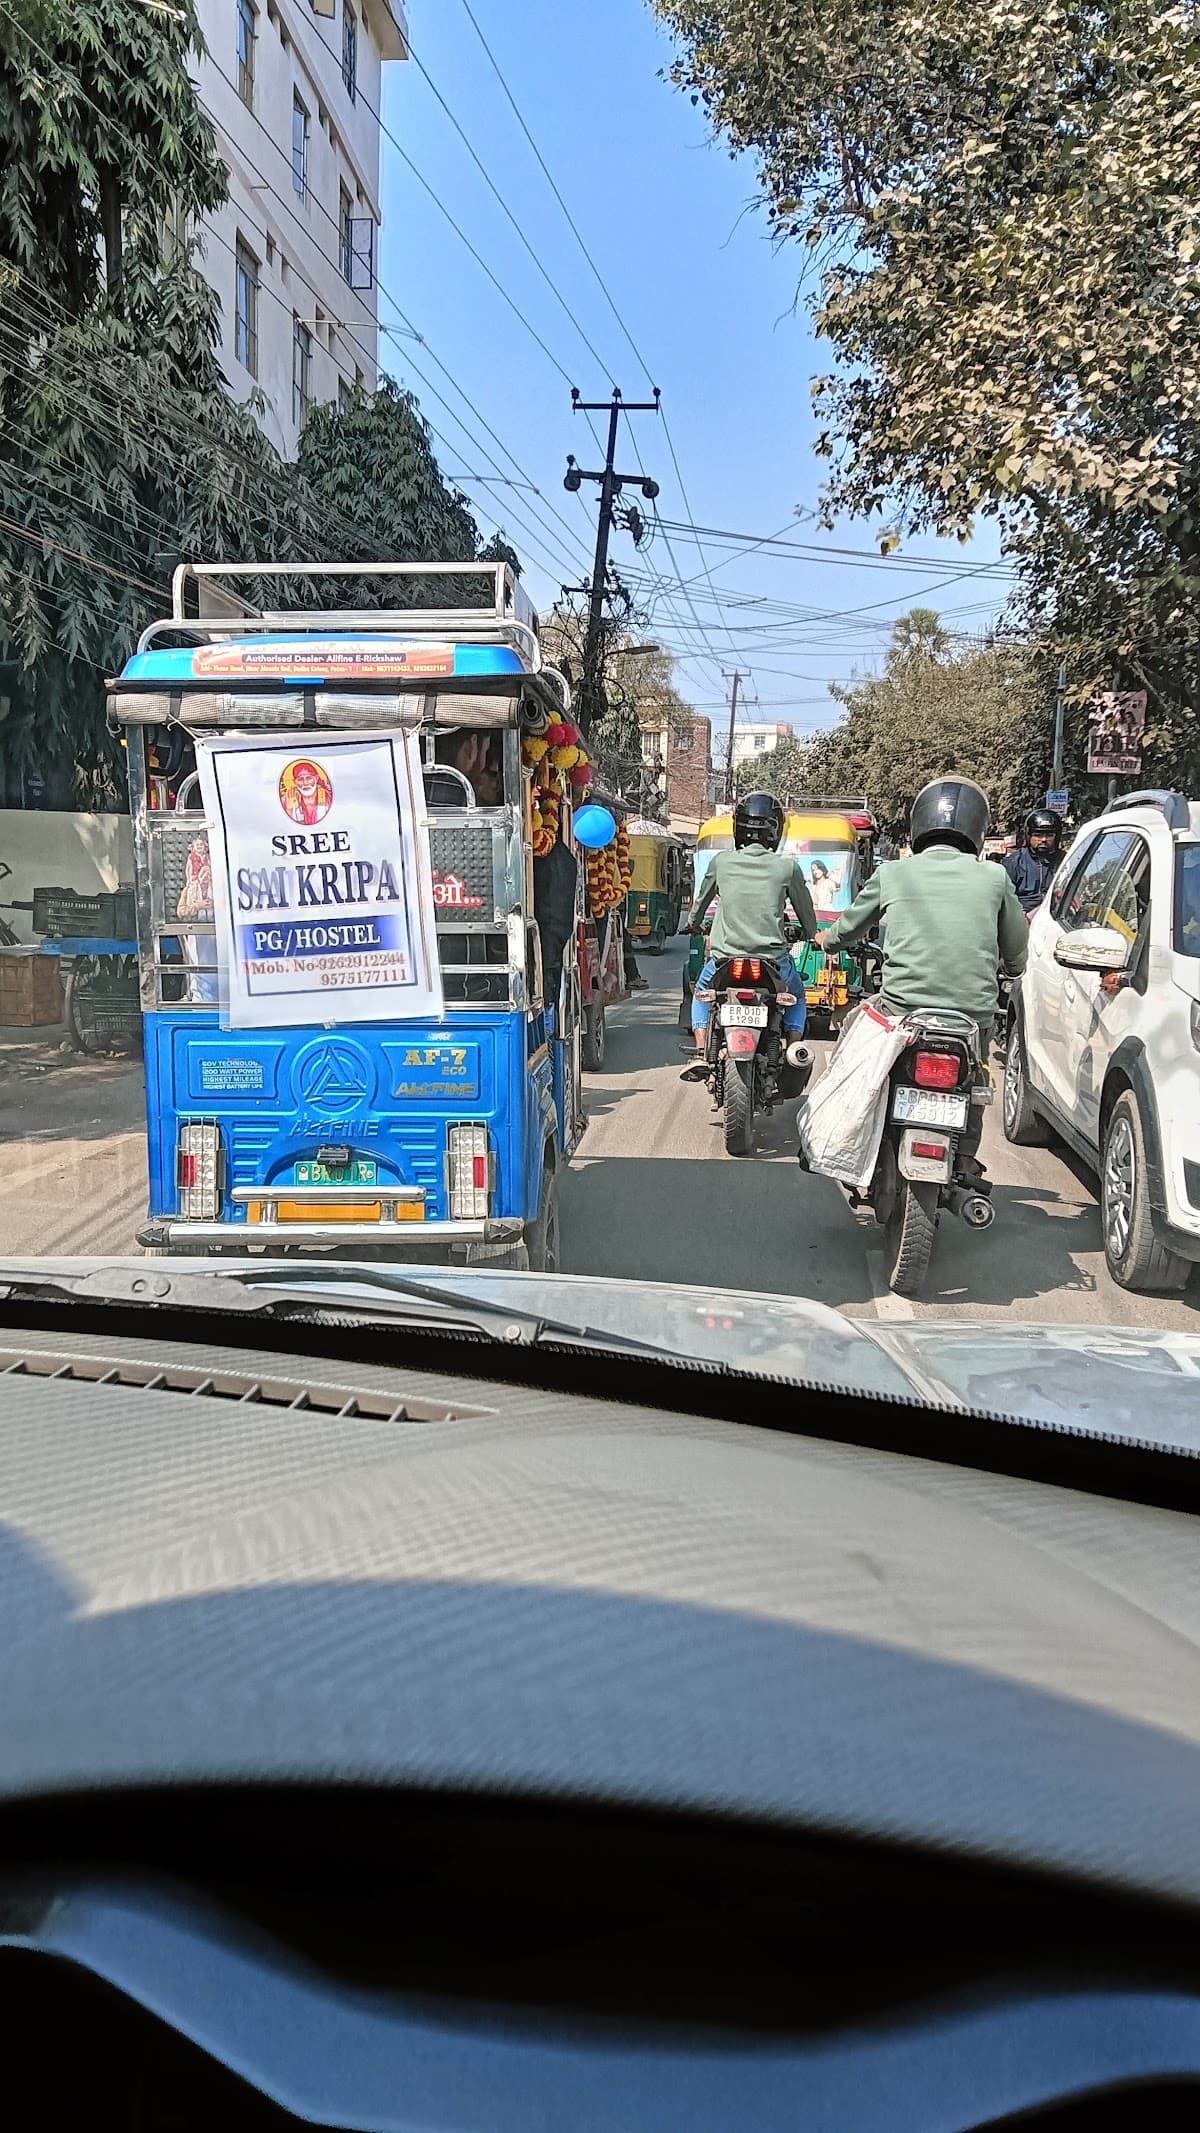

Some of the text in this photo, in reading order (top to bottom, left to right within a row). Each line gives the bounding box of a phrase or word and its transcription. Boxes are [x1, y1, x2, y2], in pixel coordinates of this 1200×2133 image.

[245, 654, 293, 663] Authorised
[355, 654, 403, 664] E-Rickshaw
[271, 831, 351, 857] SREE
[237, 859, 400, 911] SAI KRIPA
[254, 924, 381, 957] PG/HOSTEL
[251, 961, 290, 975] Mob.
[321, 968, 407, 986] 9575177111
[402, 1049, 467, 1066] AF-7
[441, 1066, 467, 1076] ECO
